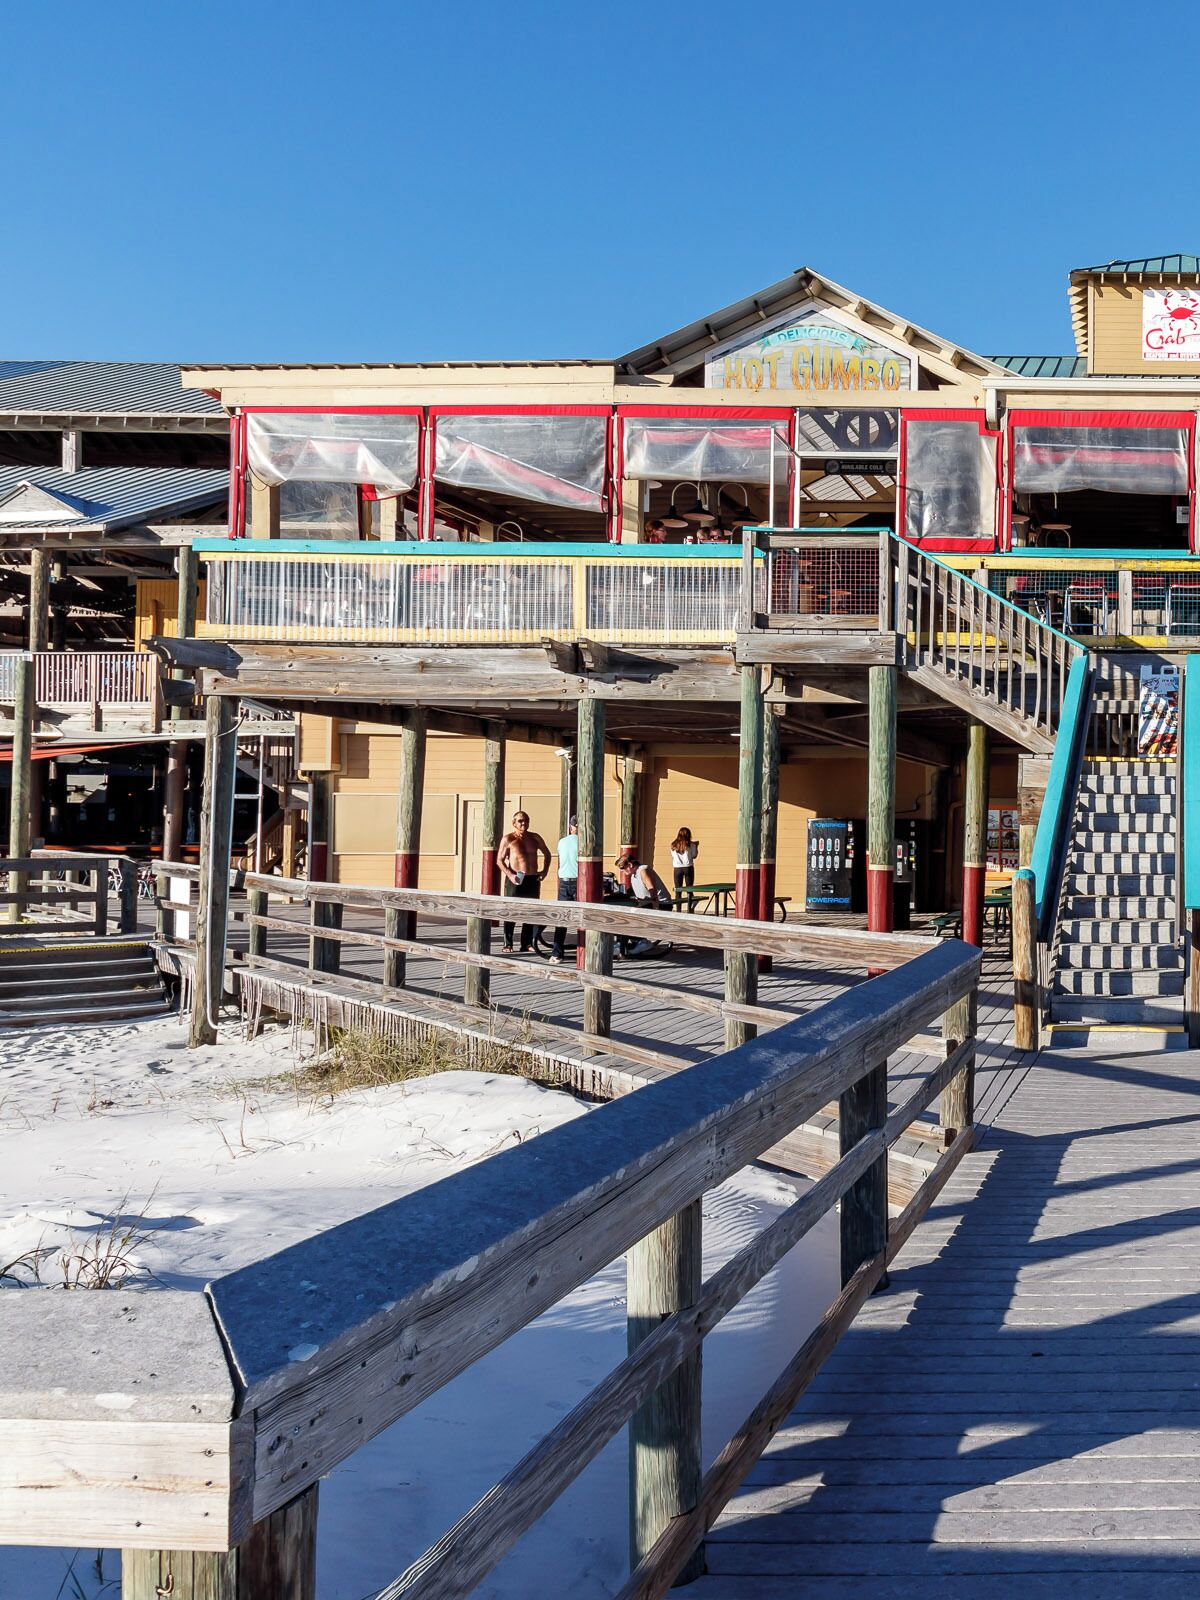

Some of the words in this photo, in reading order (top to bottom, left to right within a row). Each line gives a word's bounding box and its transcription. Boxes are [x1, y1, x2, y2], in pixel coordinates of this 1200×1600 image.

[777, 325, 849, 342] DELICIOUS
[724, 350, 783, 390] HOT
[791, 343, 901, 391] GUMBO
